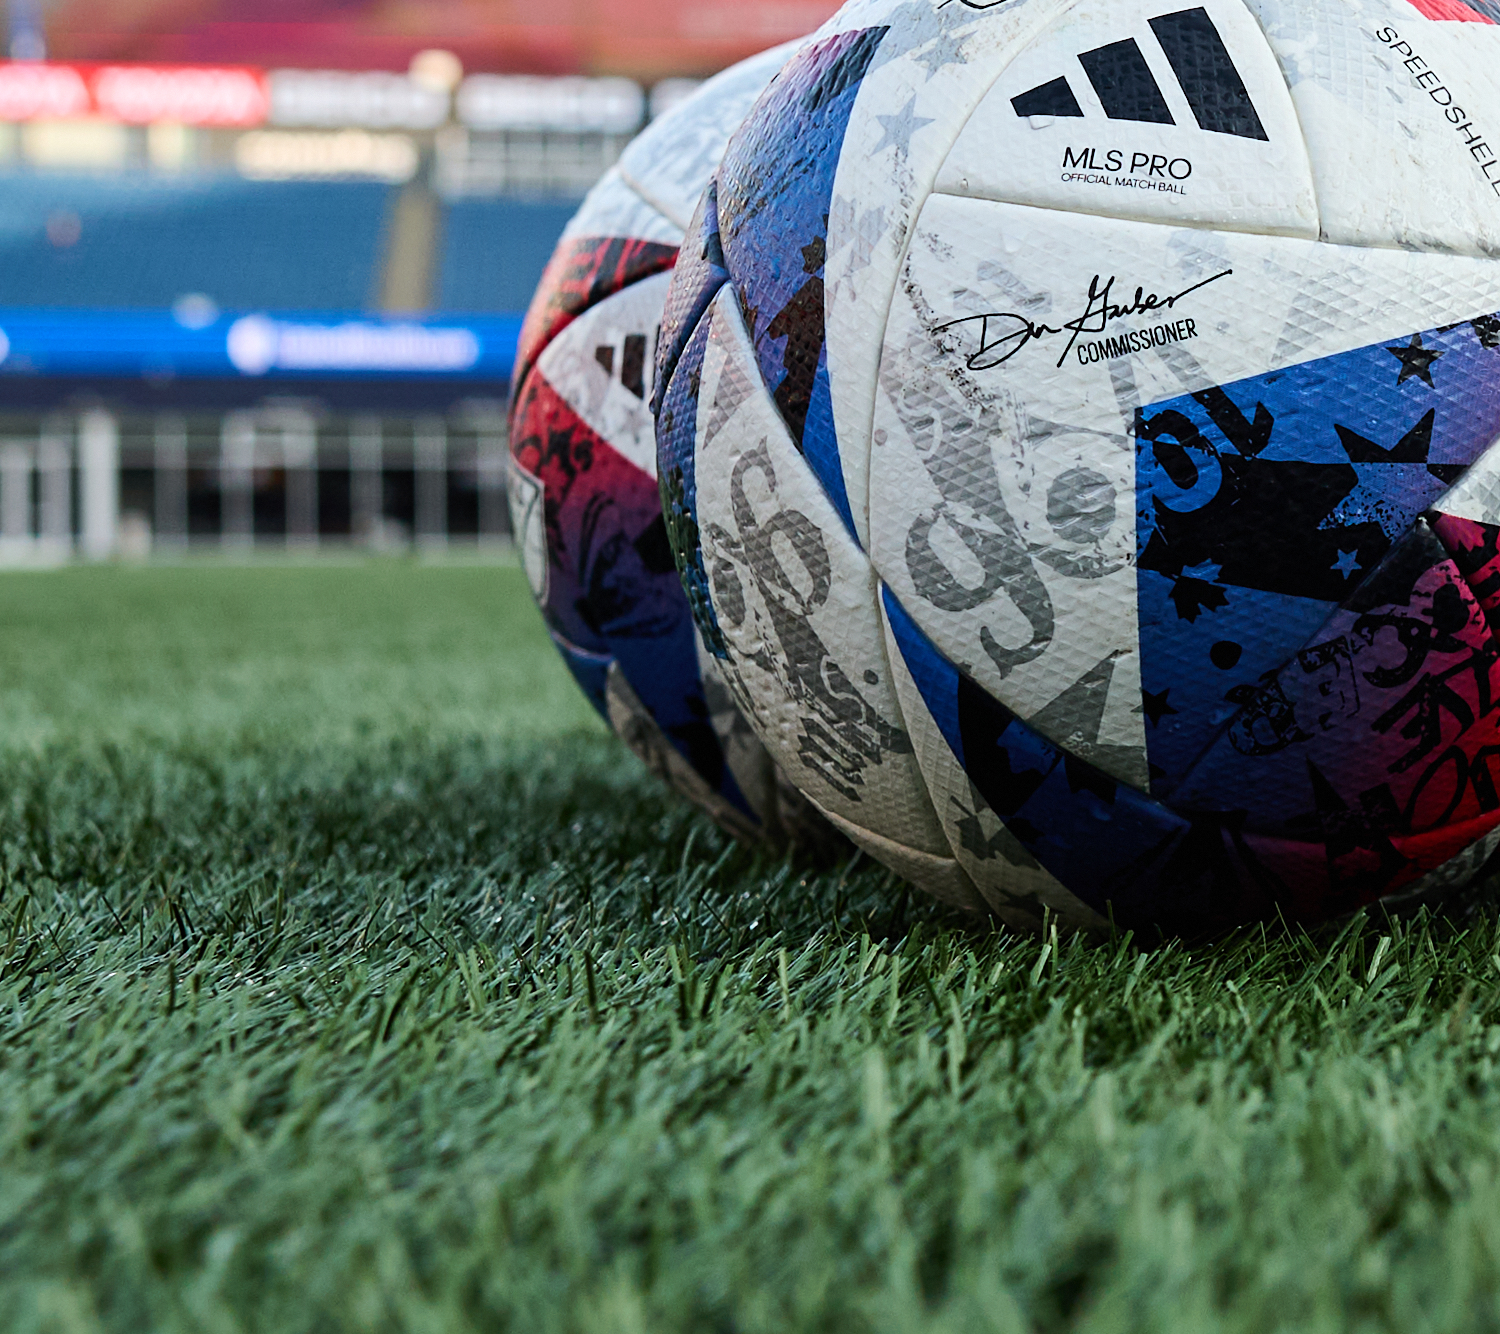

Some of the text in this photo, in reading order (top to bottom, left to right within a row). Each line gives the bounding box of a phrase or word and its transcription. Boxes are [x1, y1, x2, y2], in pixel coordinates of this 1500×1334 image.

[1062, 146, 1193, 180] MLS PRO
[1060, 172, 1188, 196] OFFICIAL MATCH BALL
[1077, 318, 1199, 366] COMMISSIONER
